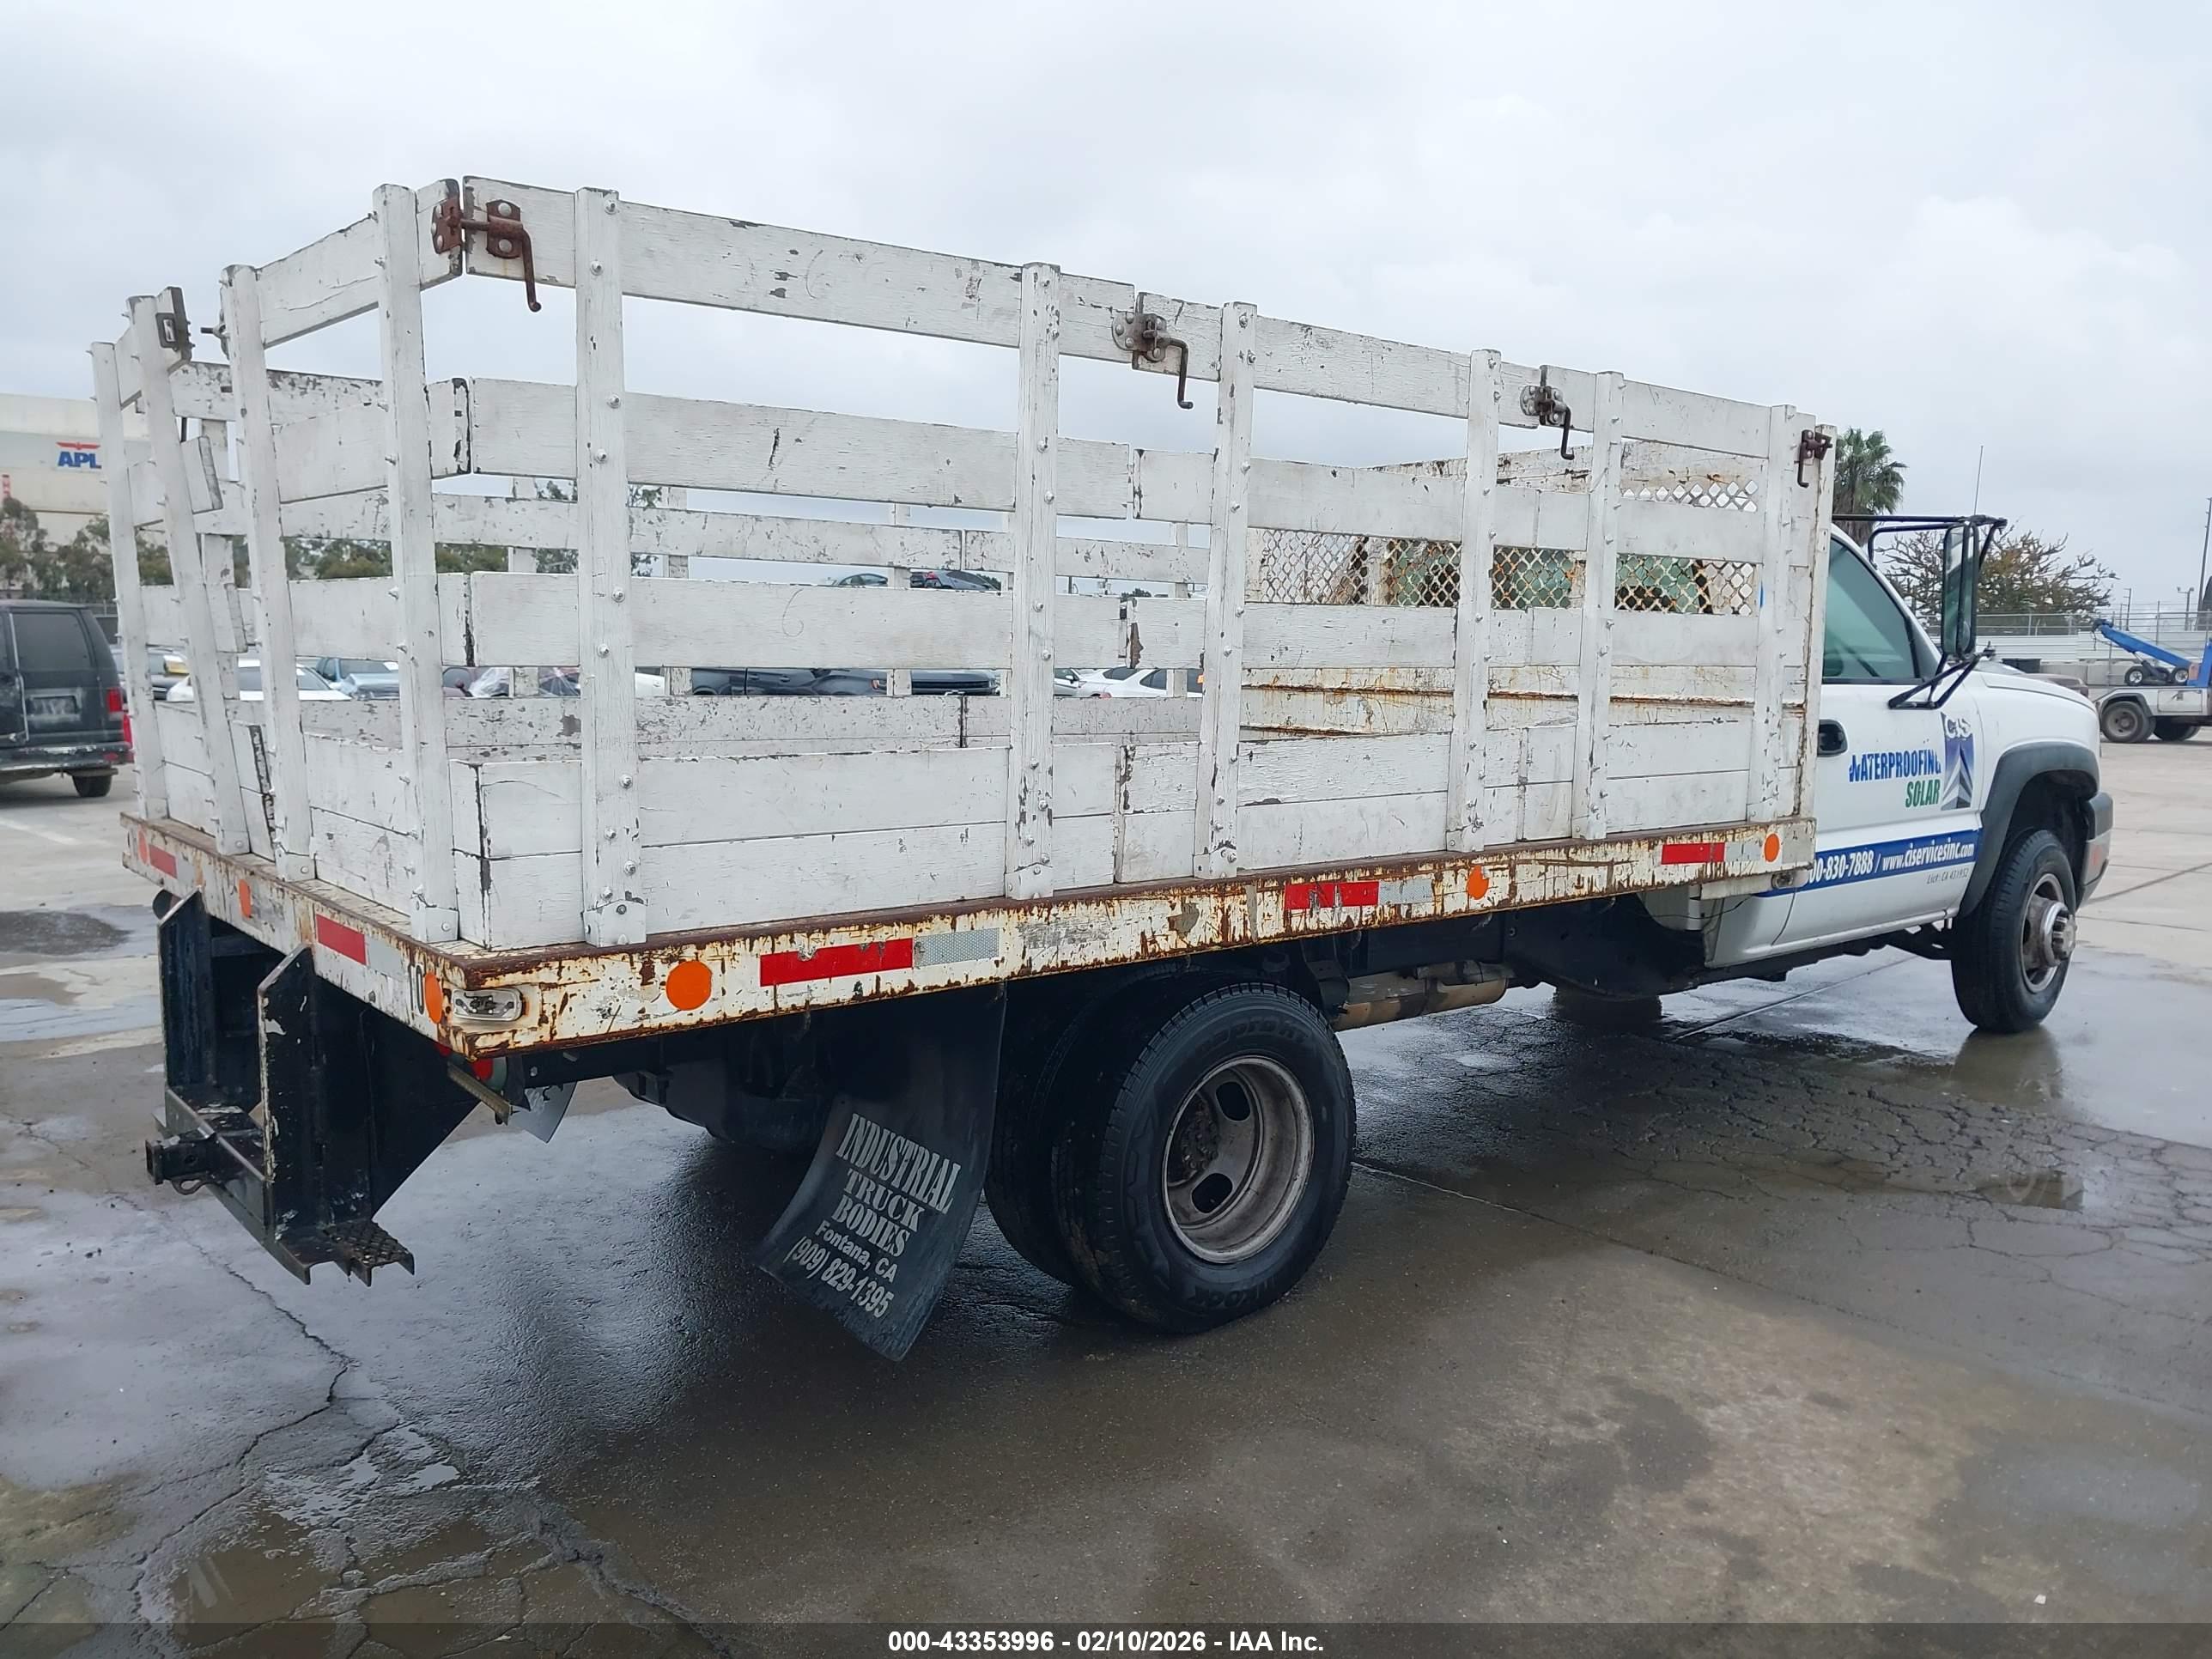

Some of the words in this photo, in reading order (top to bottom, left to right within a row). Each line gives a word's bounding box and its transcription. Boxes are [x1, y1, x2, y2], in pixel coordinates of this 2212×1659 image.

[57, 451, 102, 470] APL
[1905, 779, 1941, 808] SOLAR
[1881, 837, 1975, 872] www.ciservicesinc.com
[836, 1113, 962, 1214] INDUSTRIAL
[830, 1194, 911, 1257] BODIES
[843, 1168, 926, 1233] TRUCK
[782, 1237, 831, 1279] (909)
[821, 1258, 895, 1318] 829-1395
[815, 1219, 872, 1271] Fontana,
[875, 1257, 898, 1283] CA
